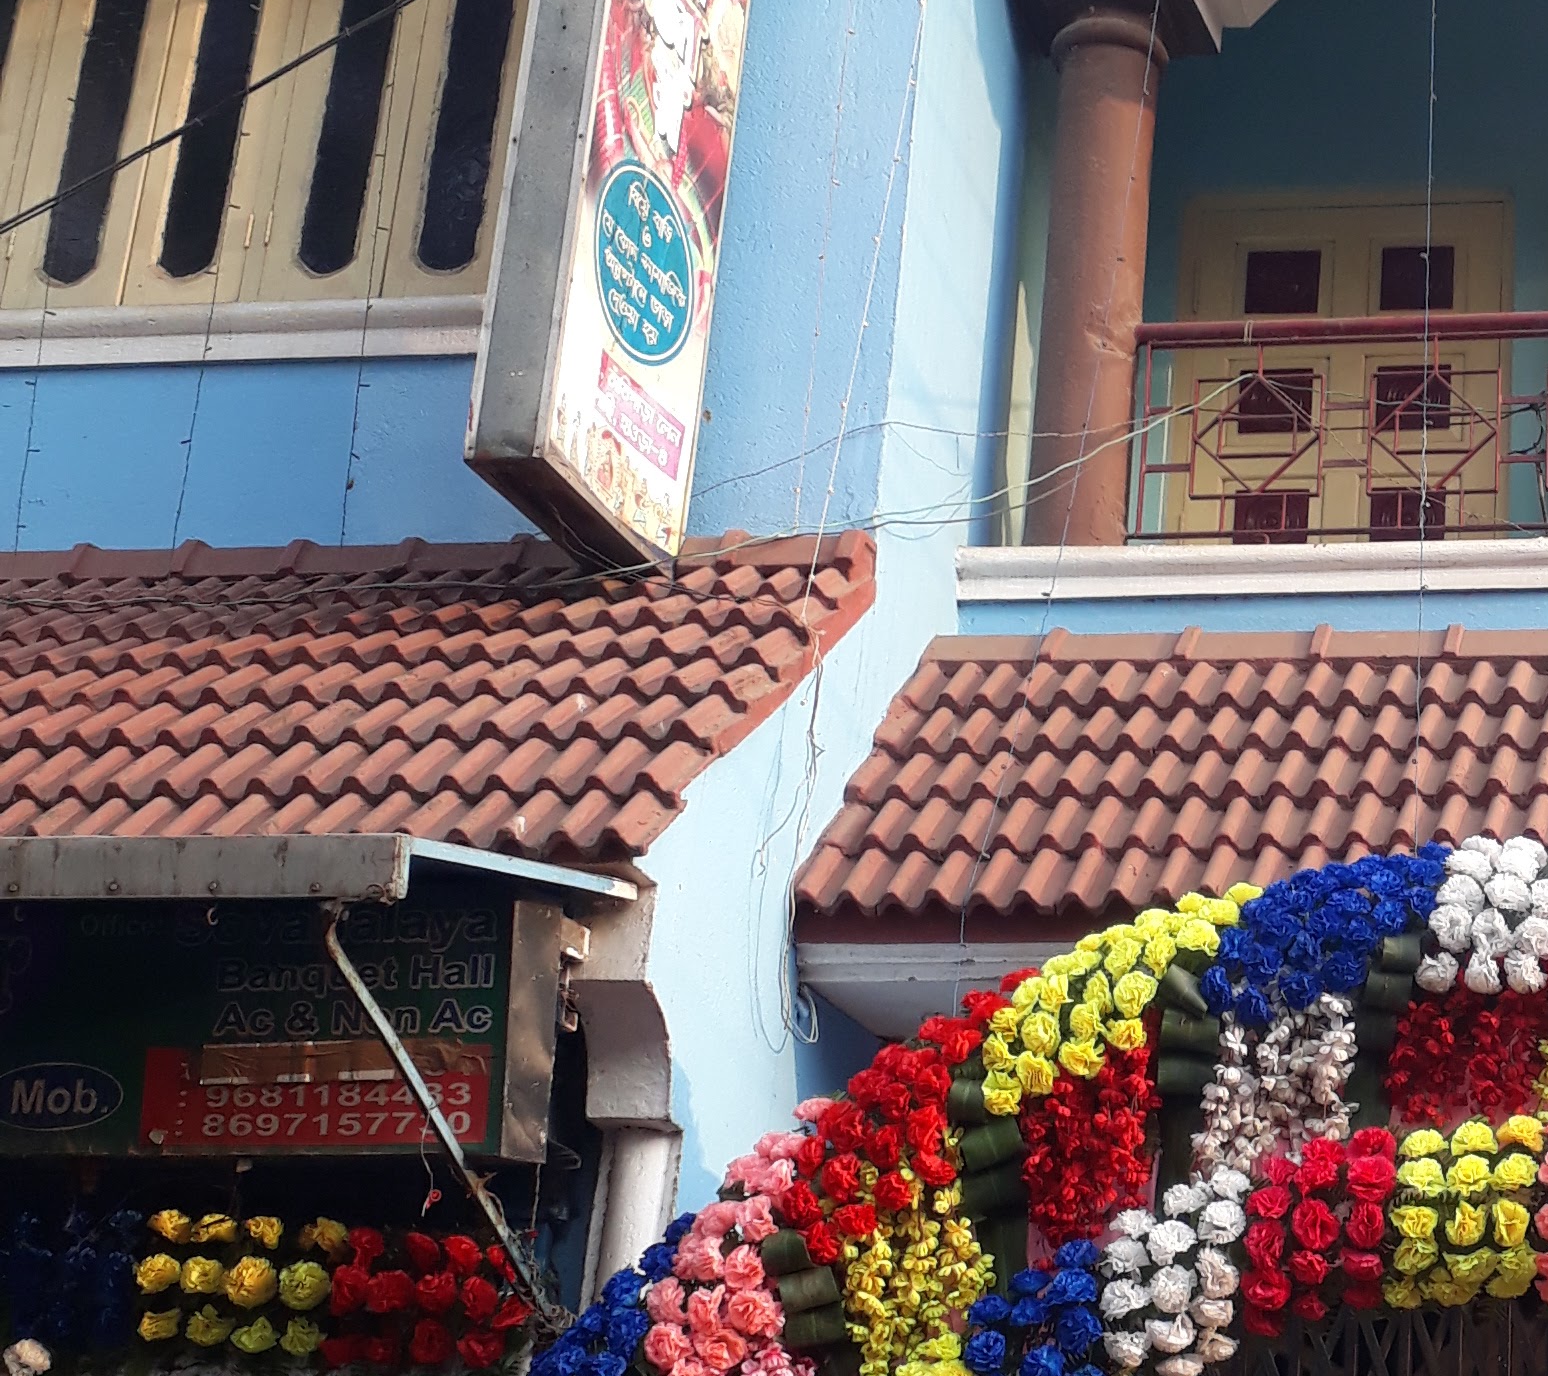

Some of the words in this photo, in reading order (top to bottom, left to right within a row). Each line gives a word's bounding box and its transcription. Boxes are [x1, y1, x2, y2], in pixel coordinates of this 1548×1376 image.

[642, 226, 652, 248] ও
[410, 952, 496, 990] Hall
[212, 1000, 275, 1038] Ac
[284, 1000, 320, 1036] &
[331, 1000, 420, 1036] Nn
[428, 998, 493, 1034] Ac
[10, 1078, 109, 1115] Mob.
